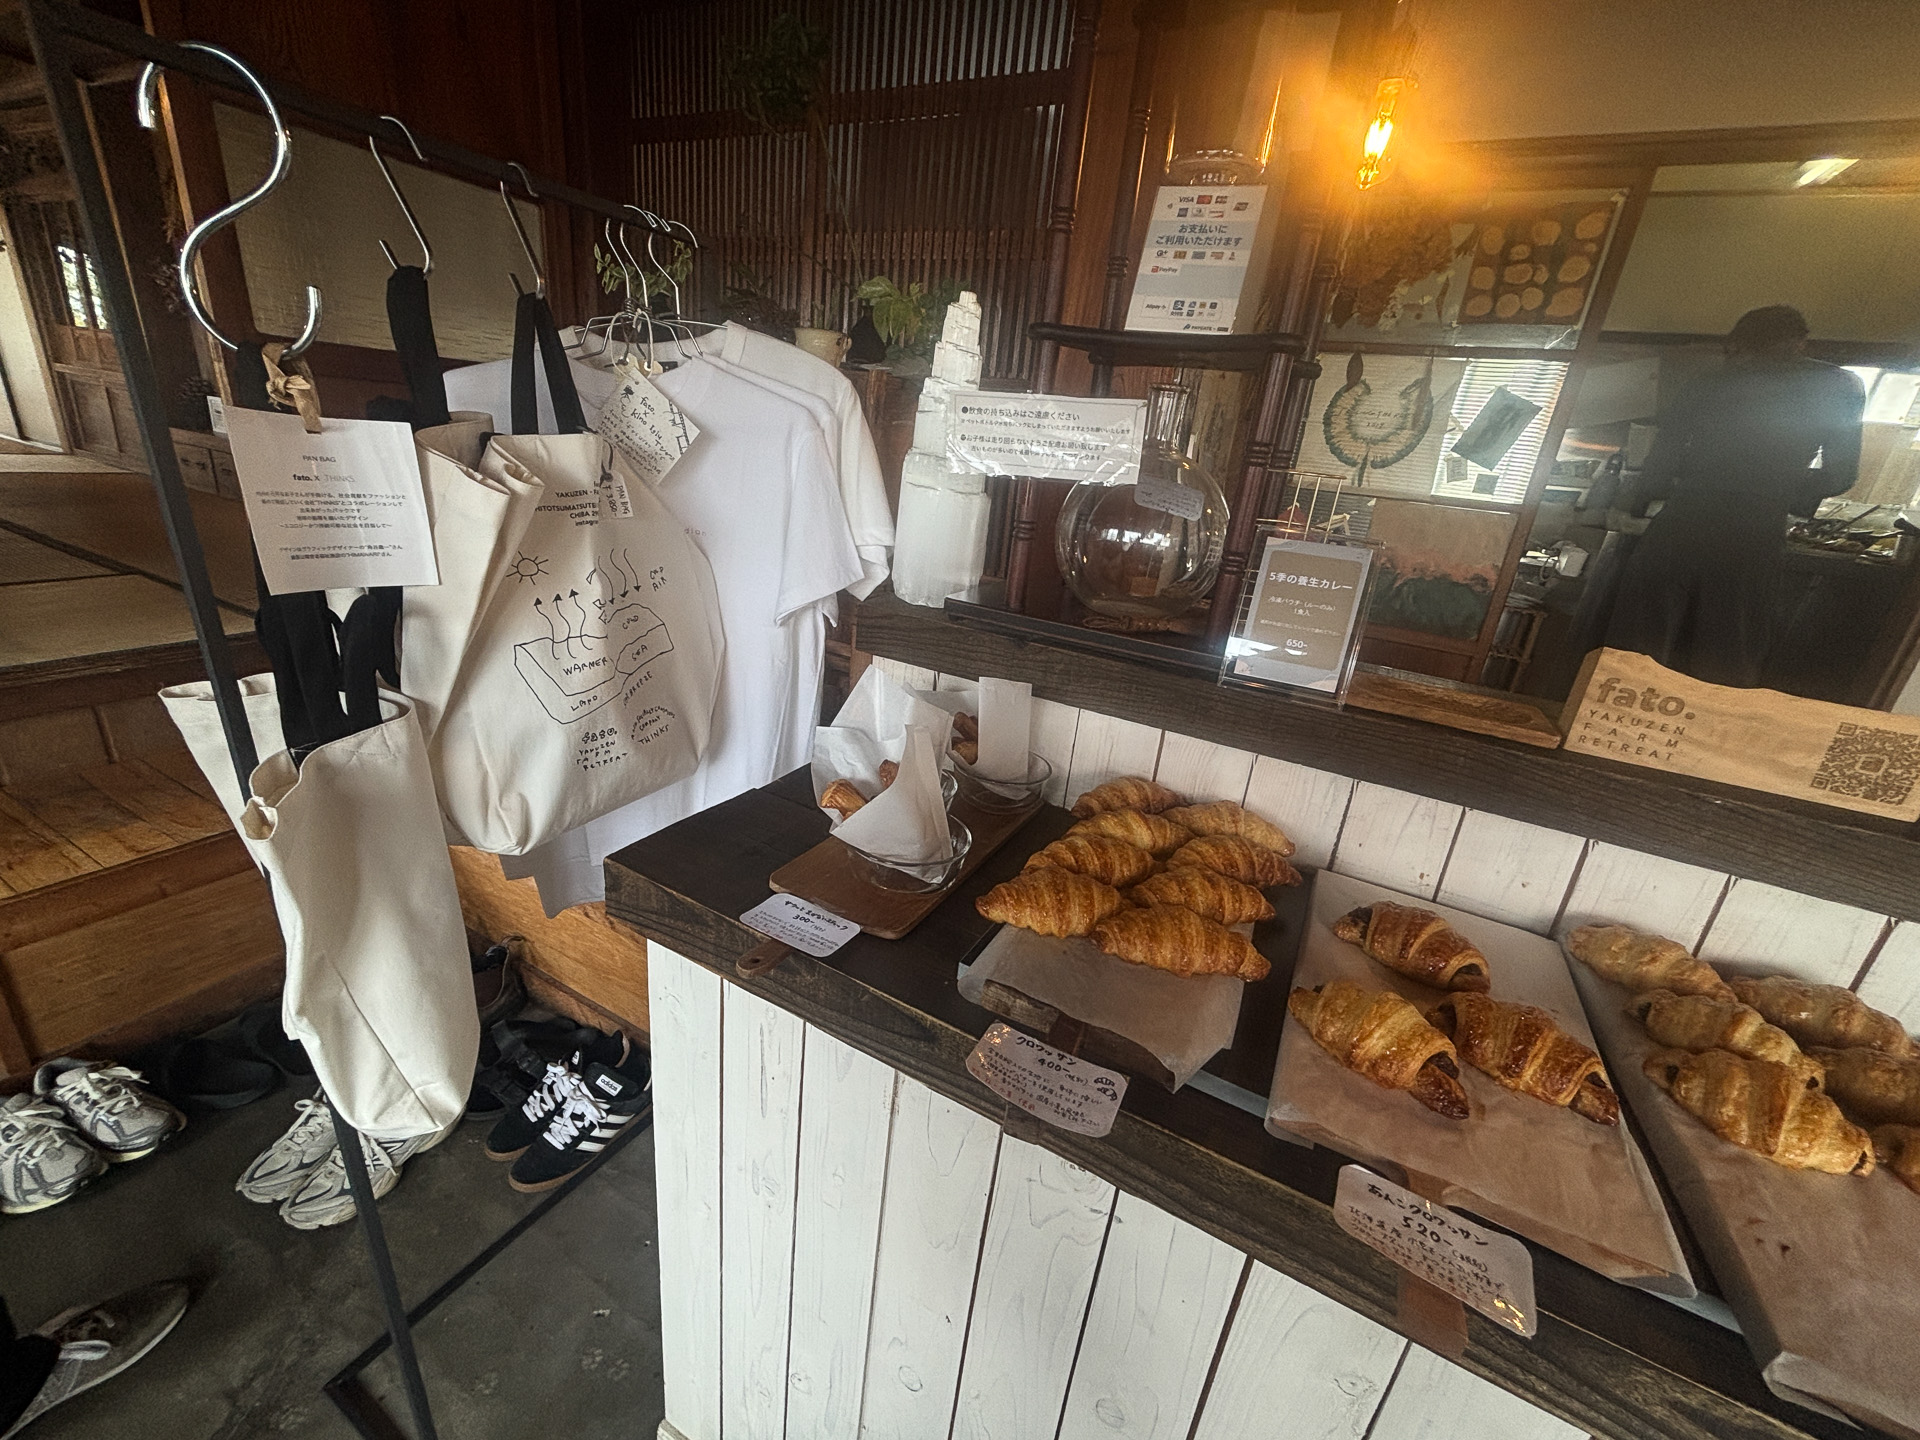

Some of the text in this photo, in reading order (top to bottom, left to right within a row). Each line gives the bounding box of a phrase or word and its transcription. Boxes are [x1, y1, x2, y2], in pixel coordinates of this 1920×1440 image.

[1178, 224, 1228, 234] お支払いに
[1156, 235, 1242, 246] ご利用いただけます
[555, 489, 588, 498] YAKUZEN
[1269, 572, 1353, 590] 5季の養生カレー
[563, 656, 608, 676] WARMER
[1597, 677, 1696, 720] fato.
[1589, 709, 1686, 736] YAKUZEN
[637, 724, 669, 745] THINKS
[1578, 734, 1674, 761] RETREAT
[1015, 1036, 1077, 1066] クロワッサン
[600, 1078, 618, 1092] adidas
[1367, 1183, 1489, 1246] あんこクロワッサン
